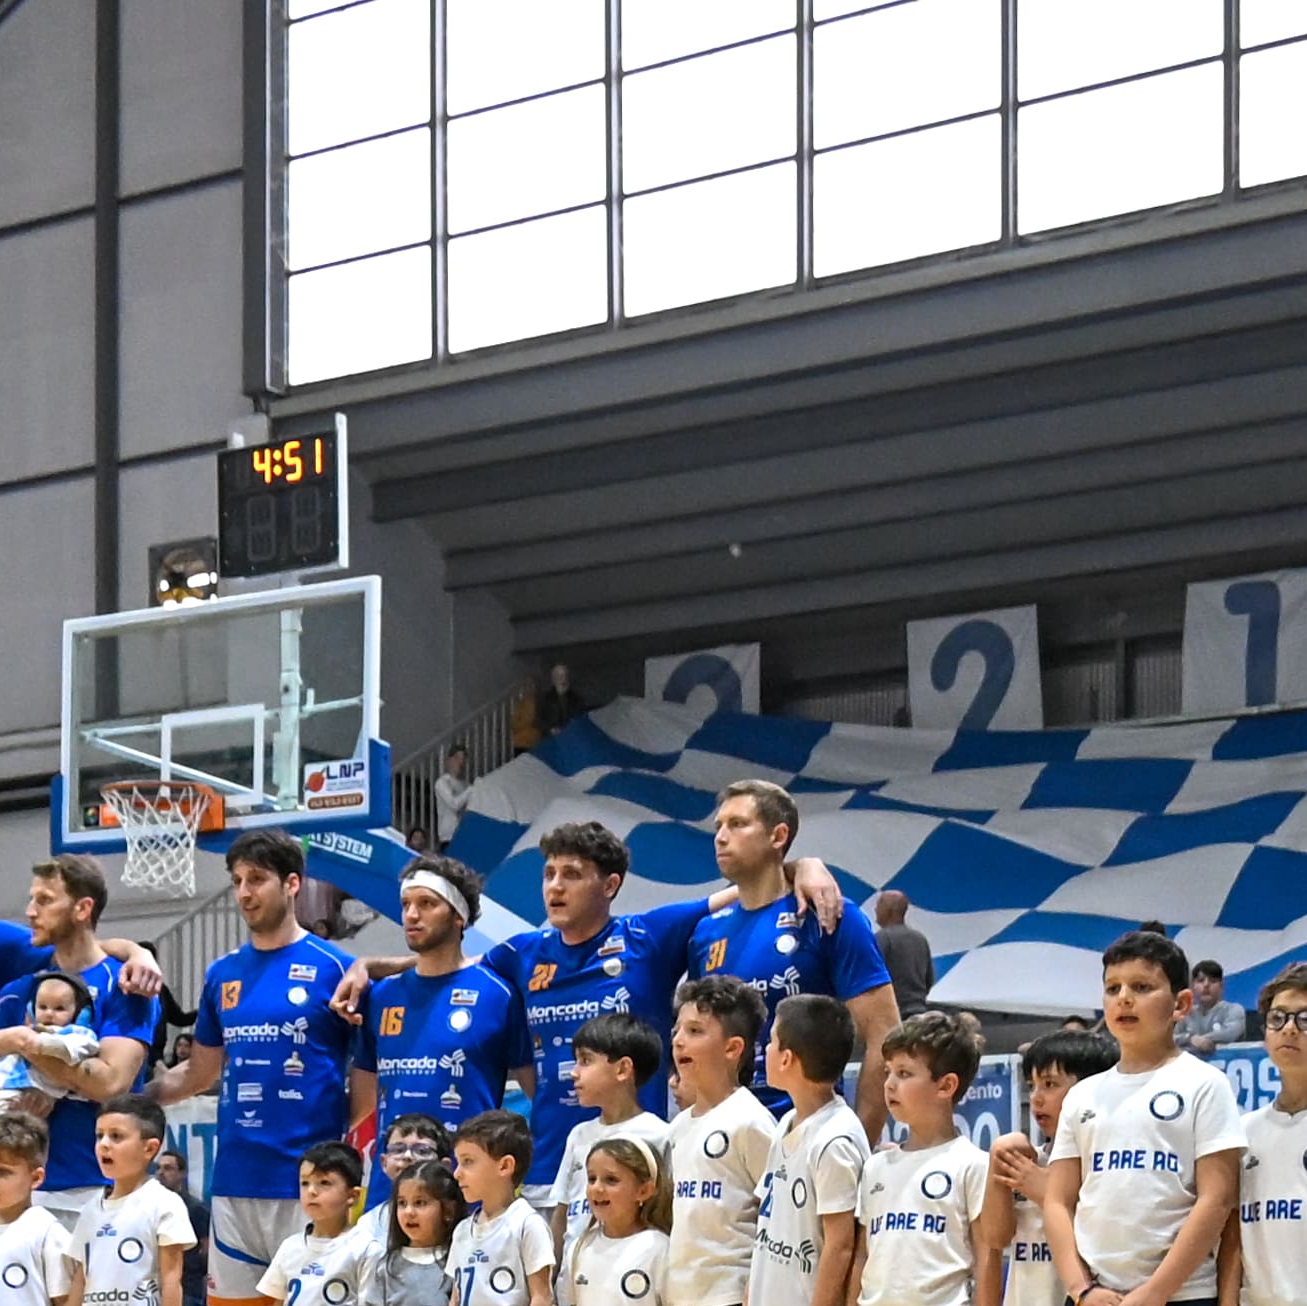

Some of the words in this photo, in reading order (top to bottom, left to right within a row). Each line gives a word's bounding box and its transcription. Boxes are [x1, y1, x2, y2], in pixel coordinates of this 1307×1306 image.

[253, 437, 322, 484] 4:51
[326, 762, 365, 779] LNP
[706, 938, 728, 972] 31
[528, 964, 558, 991] 21
[380, 1007, 405, 1036] 16
[1108, 1150, 1147, 1170] ARE
[1153, 1151, 1179, 1172] AG
[701, 1181, 722, 1199] AG
[1265, 1200, 1302, 1220] ARE
[886, 1212, 919, 1230] ARE
[923, 1214, 947, 1233] AG
[1032, 1243, 1052, 1261] AR
